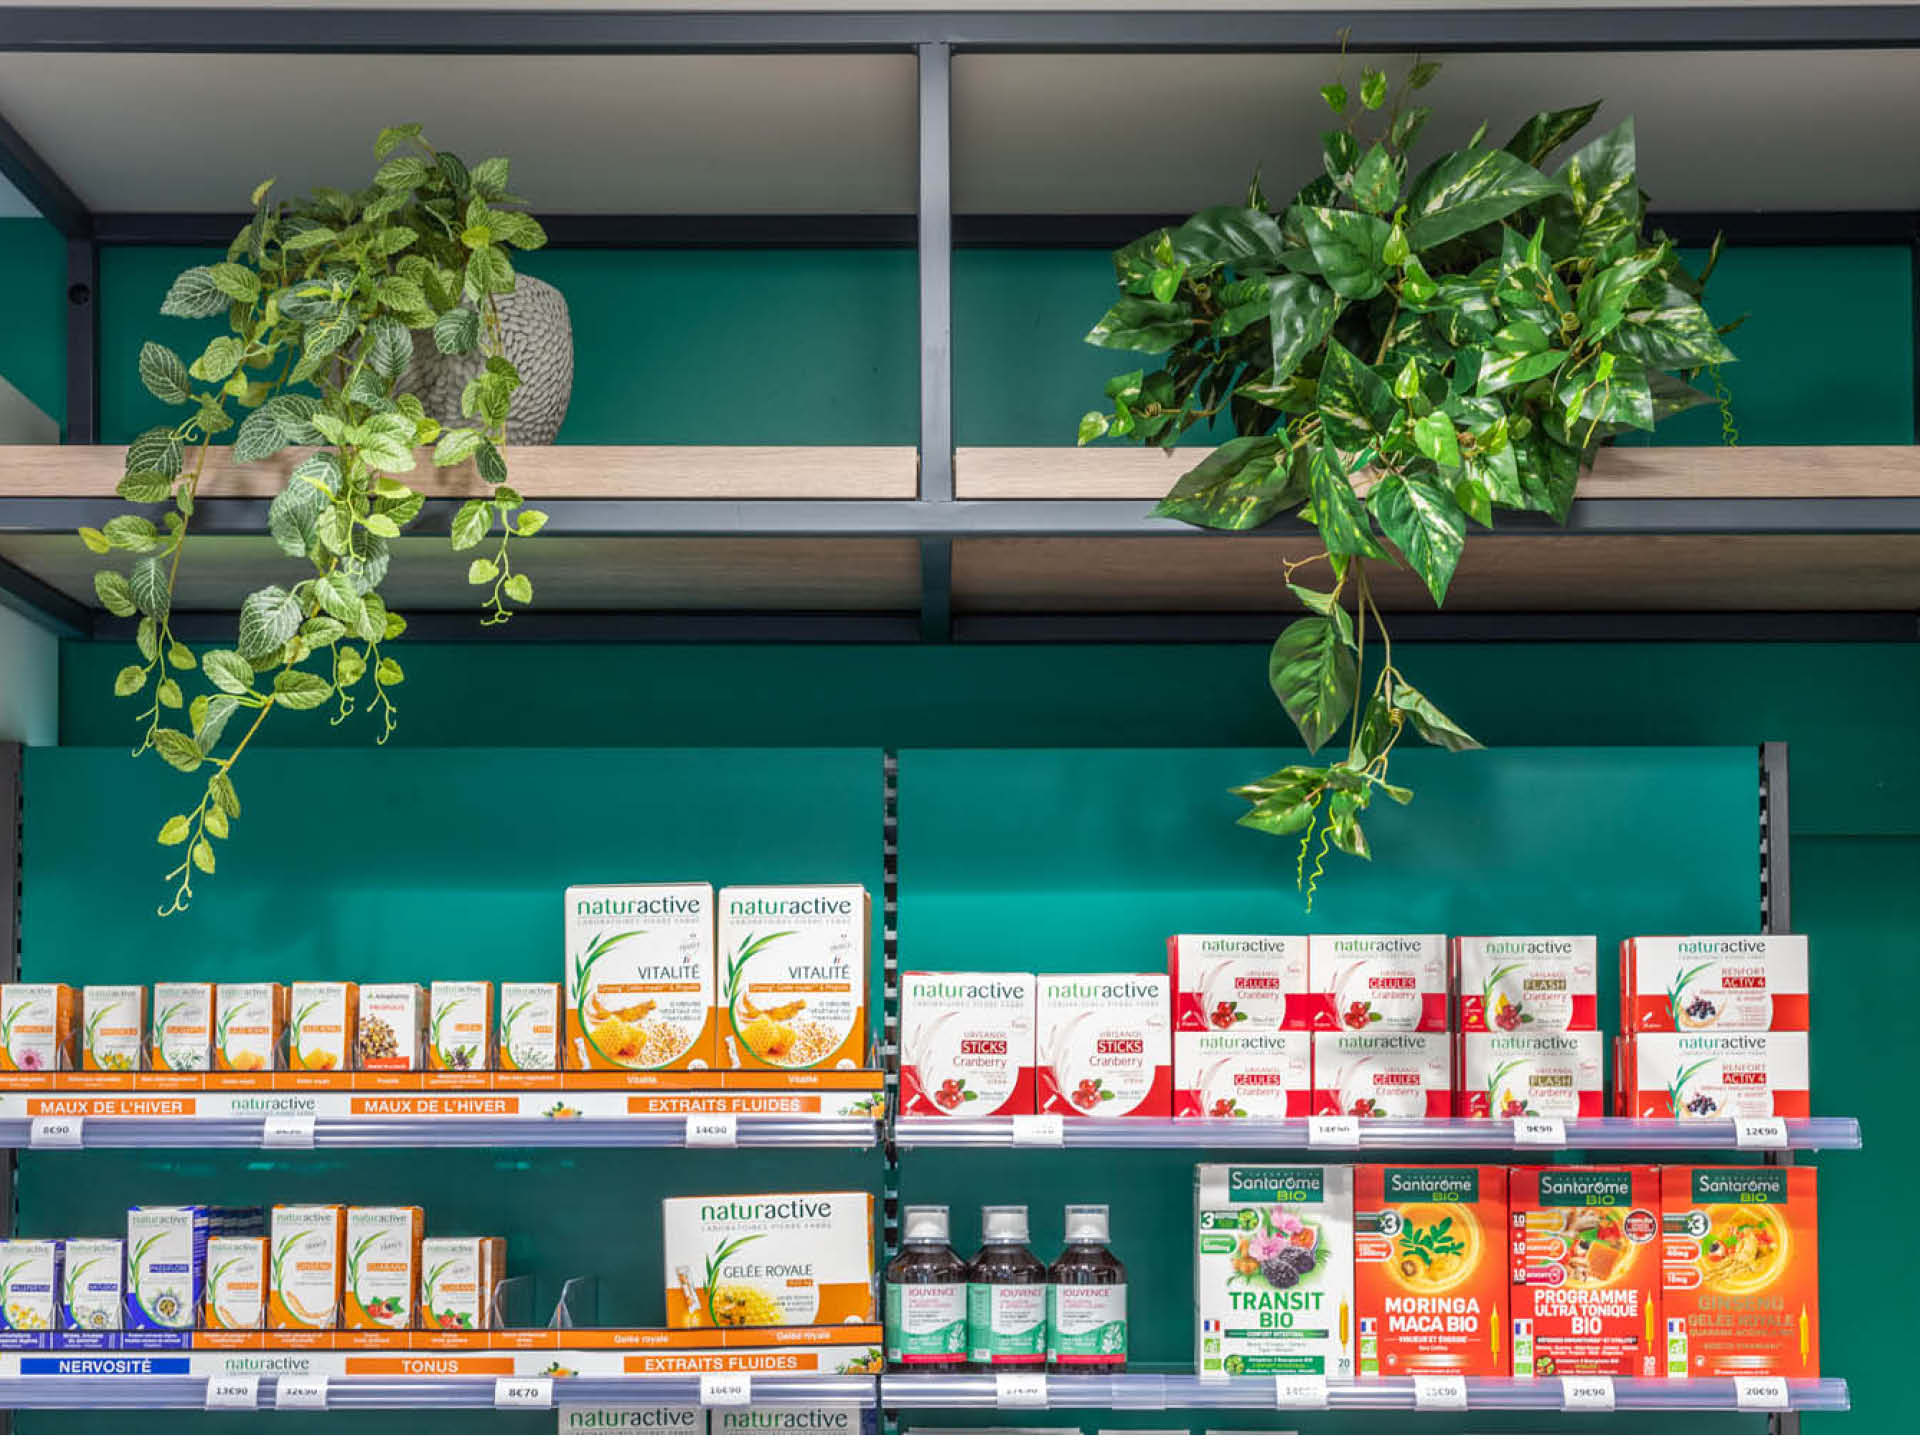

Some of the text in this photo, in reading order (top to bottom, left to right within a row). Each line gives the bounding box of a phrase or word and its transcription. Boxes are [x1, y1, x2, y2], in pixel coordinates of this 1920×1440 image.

[578, 896, 700, 915] naturactive
[731, 896, 852, 915] naturactive
[1202, 938, 1285, 953] naturactive
[1334, 938, 1422, 953] naturactive
[1486, 941, 1572, 954] naturactive
[1678, 939, 1766, 953] naturactive
[638, 963, 700, 979] VITALITÉ
[788, 963, 850, 979] VITALITÉ
[1723, 978, 1755, 987] ACTIV
[913, 982, 1024, 999] naturactive
[1048, 981, 1160, 999] naturactive
[963, 1042, 1006, 1054] STICKS
[1098, 1041, 1142, 1053] STICKS
[1200, 1035, 1286, 1049] naturactive
[1338, 1034, 1426, 1049] naturactive
[1491, 1036, 1578, 1050] naturactive
[1679, 1035, 1766, 1048] naturactive
[952, 1056, 1008, 1069] Cranberry
[1089, 1055, 1144, 1068] Cranberry
[1724, 1074, 1756, 1083] ACTIV
[40, 1100, 183, 1114] MAUX DE L'HIVER
[231, 1096, 315, 1111] naturactive
[364, 1100, 506, 1113] MAUX DE L'HIVER
[648, 1099, 800, 1112] EXTRAITS FLUIDES
[43, 1126, 69, 1134] 8€90
[696, 1125, 728, 1134] 14€90
[1746, 1127, 1778, 1137] 12€90
[1232, 1171, 1320, 1190] Santarôme
[1391, 1173, 1472, 1191] Santarôme
[1541, 1176, 1629, 1195] Santarôme
[1699, 1175, 1780, 1192] Santarôme
[1276, 1190, 1307, 1201] BIO
[1432, 1191, 1459, 1201] BIO
[1585, 1194, 1615, 1205] BIO
[1740, 1192, 1767, 1202] BIO
[701, 1199, 832, 1222] naturactive
[1202, 1212, 1215, 1228] 3
[1513, 1214, 1526, 1224] 10
[1513, 1242, 1526, 1251] 10
[723, 1263, 813, 1279] GELÉE ROYALE
[1513, 1269, 1526, 1279] 10
[908, 1288, 956, 1297] JOUVENCE
[1064, 1288, 1110, 1297] JOUVENCE
[1534, 1289, 1638, 1304] PROGRAMME
[1228, 1291, 1325, 1310] TRANSIT
[1385, 1297, 1480, 1314] MORINGA
[1698, 1295, 1784, 1311] GINSENG
[1534, 1304, 1638, 1318] ULTRA TONIQUE
[1259, 1312, 1294, 1328] BIO
[1389, 1315, 1478, 1332] MACA BIO
[1571, 1317, 1602, 1335] BIO
[1688, 1312, 1734, 1327] GELÉE
[614, 1334, 669, 1345] Gelée royale
[59, 1358, 152, 1373] NERVOSITÉ
[225, 1356, 309, 1370] naturactive
[402, 1360, 459, 1373] TONUS
[645, 1357, 797, 1371] EXTRAITS FLUIDES
[1338, 1358, 1350, 1368] 20
[216, 1387, 248, 1395] 13€90
[508, 1388, 538, 1397] 8€70
[710, 1385, 742, 1395] 16€90
[1573, 1388, 1605, 1397] 29€90
[1745, 1387, 1778, 1396] 20€90
[570, 1408, 695, 1428] naturactive
[723, 1409, 848, 1429] naturactive
